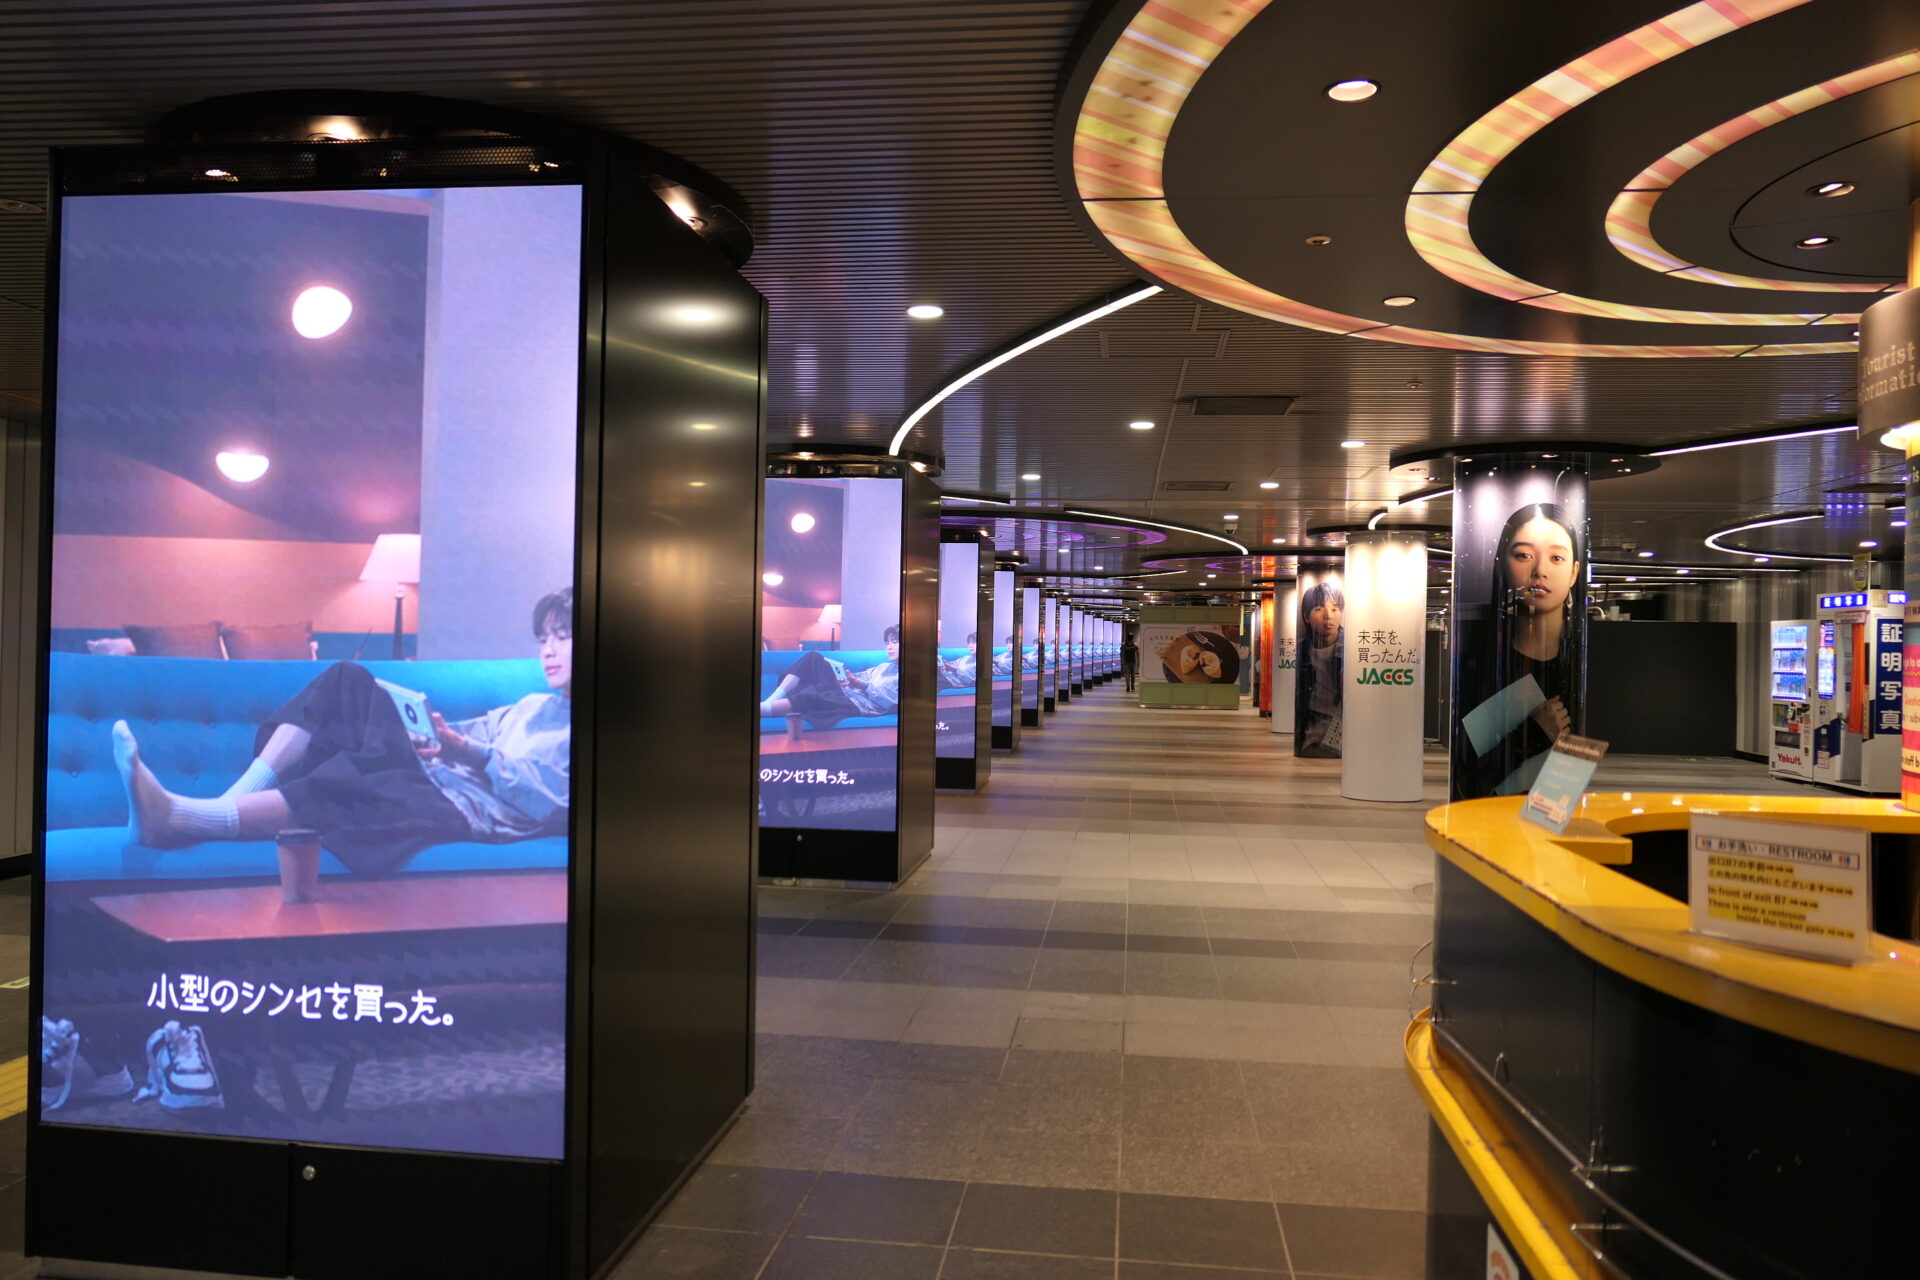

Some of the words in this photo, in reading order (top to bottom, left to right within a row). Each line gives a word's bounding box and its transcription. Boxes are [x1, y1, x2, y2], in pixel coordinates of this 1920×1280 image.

[1357, 629, 1402, 646] 未来を、
[1357, 647, 1420, 665] 買ったんだ。
[1356, 667, 1415, 686] JACCS
[1880, 622, 1904, 730] 証明写真
[1768, 844, 1833, 863] RESTROOM
[147, 972, 454, 1027] 小型のシンセを買った。
